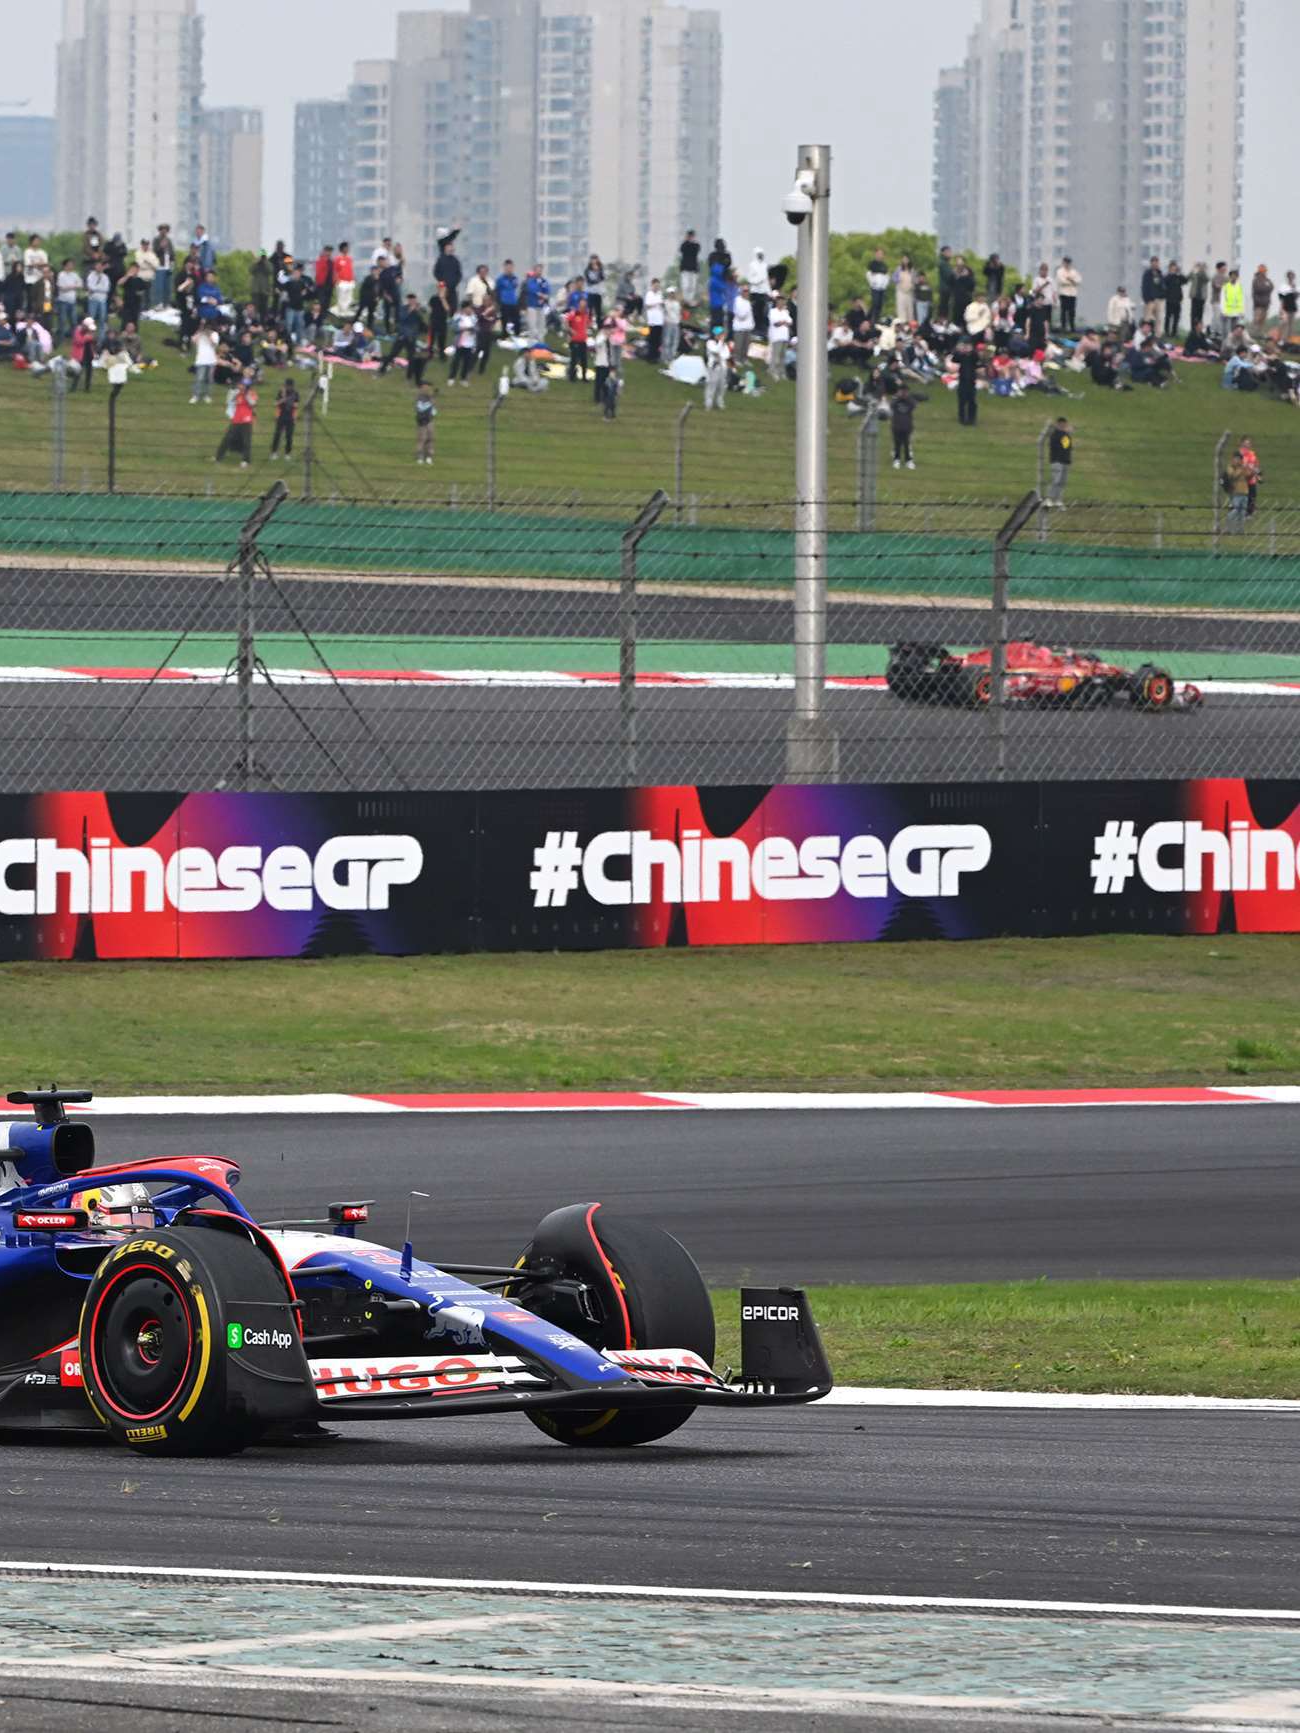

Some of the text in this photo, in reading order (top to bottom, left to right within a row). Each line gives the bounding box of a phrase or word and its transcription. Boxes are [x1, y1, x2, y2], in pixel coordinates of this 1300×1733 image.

[530, 824, 992, 907] #ChineseGP
[1091, 821, 1300, 900] #Chin
[37, 1216, 67, 1225] ORLEN
[112, 1239, 177, 1262] ZERO
[243, 1328, 270, 1345] Cash
[271, 1329, 292, 1349] App
[126, 1424, 168, 1443] PIRELLI
